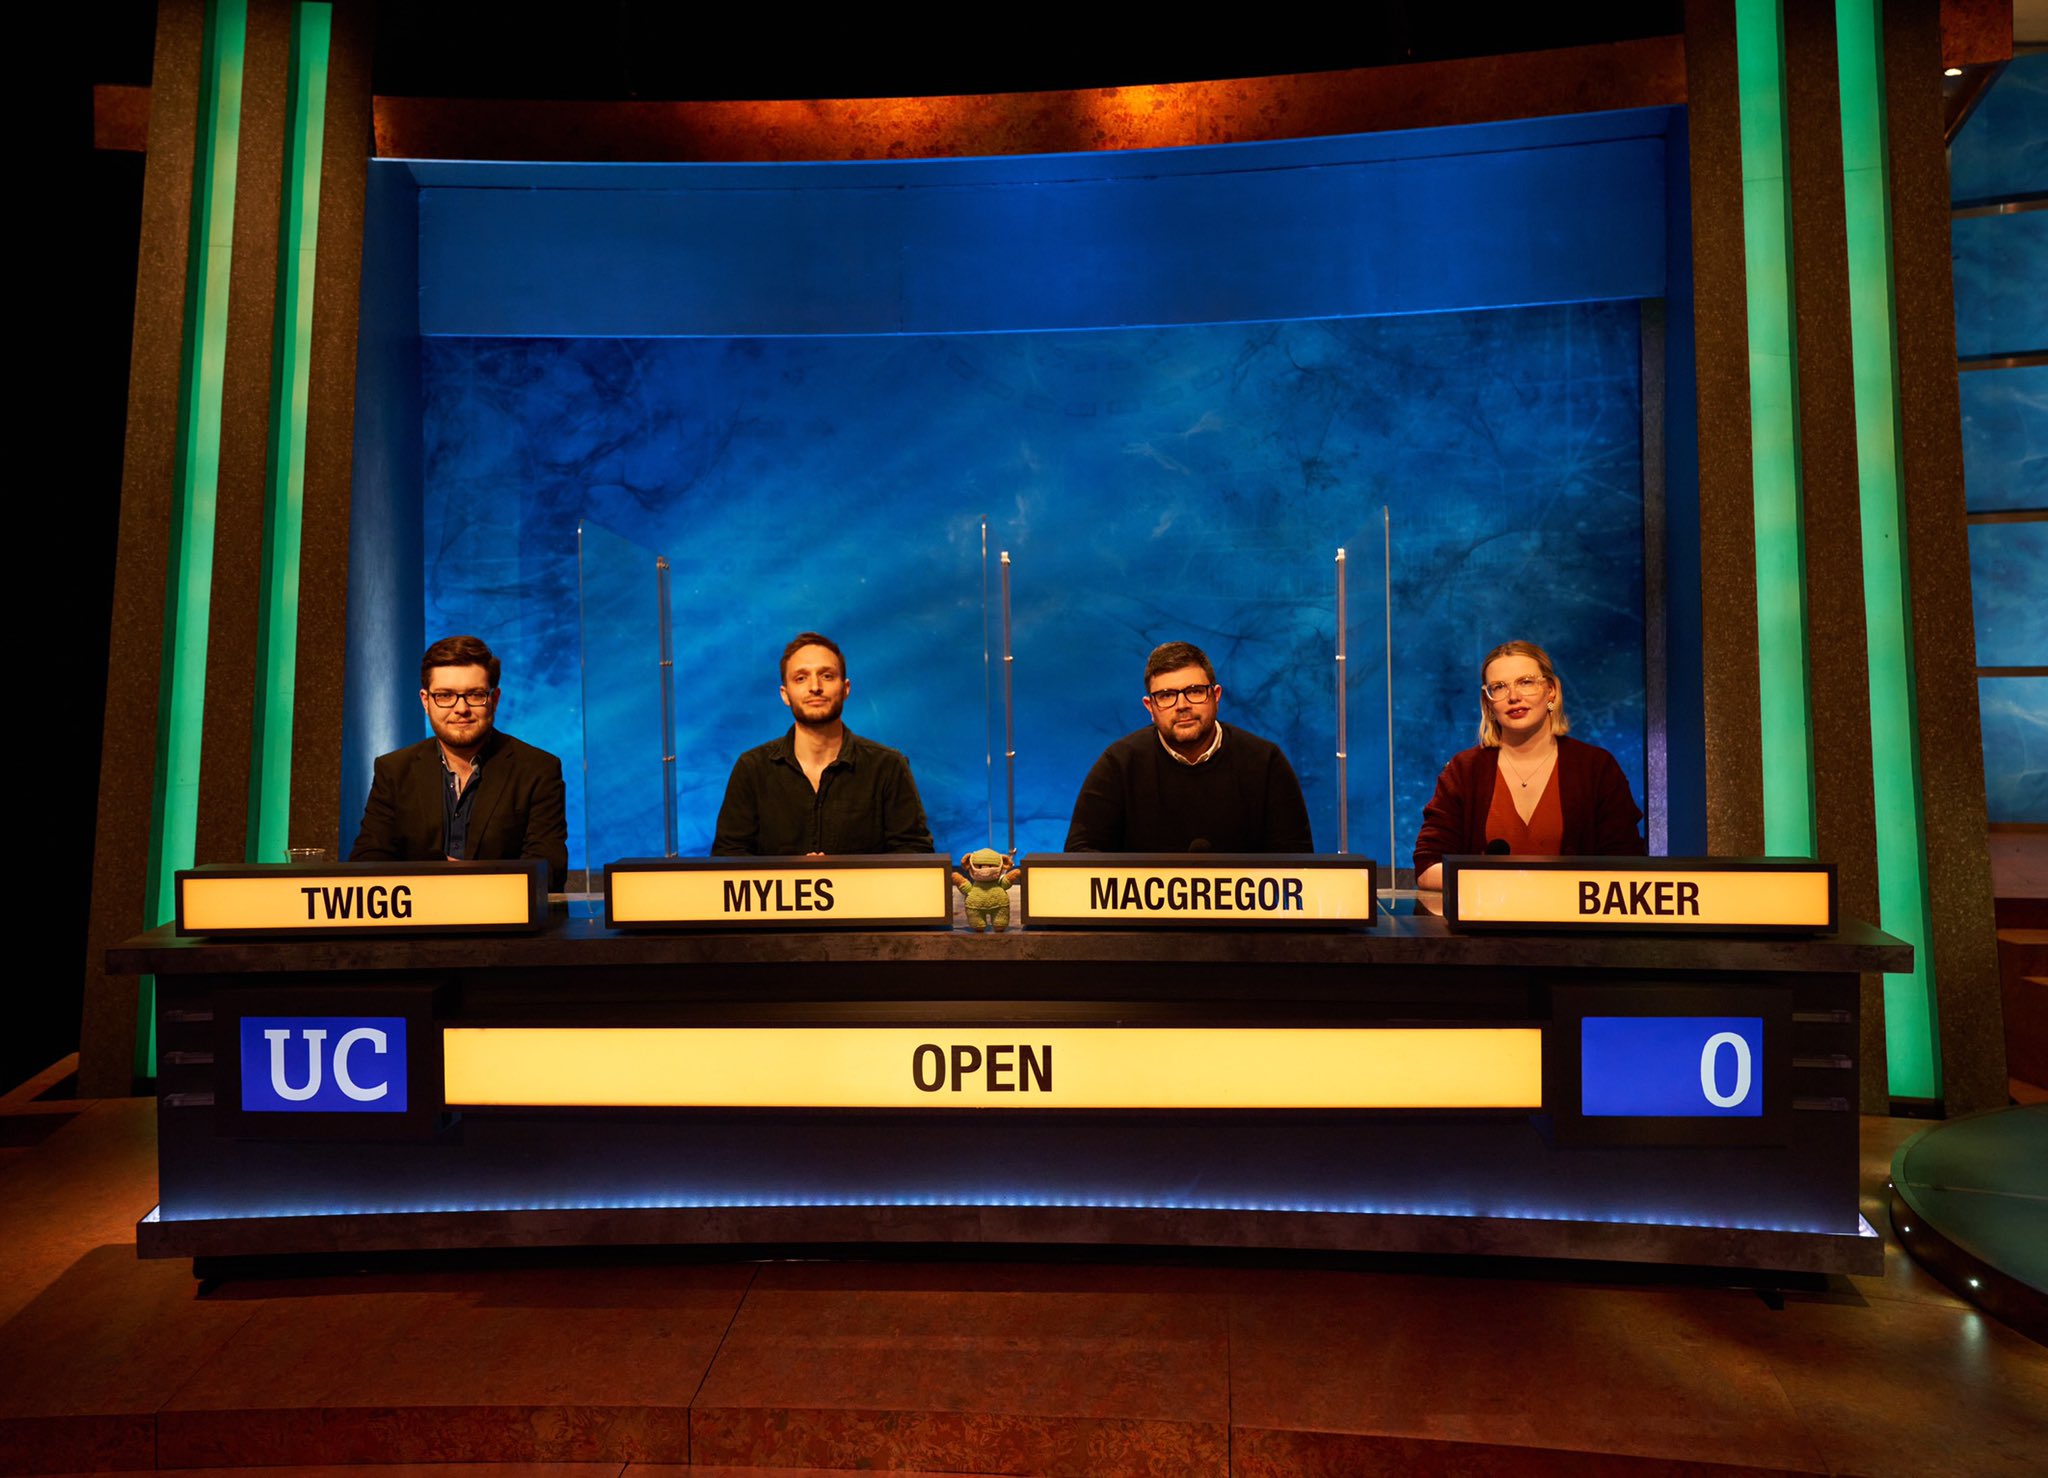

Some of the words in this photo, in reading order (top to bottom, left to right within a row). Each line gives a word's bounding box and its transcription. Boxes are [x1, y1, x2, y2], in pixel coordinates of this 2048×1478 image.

[301, 885, 412, 920] TWIGG
[724, 879, 834, 912] MYLES
[1091, 877, 1304, 911] MACGREGOR
[1579, 881, 1700, 916] BAKER
[264, 1027, 388, 1102] UC
[913, 1044, 1052, 1092] OPEN
[1700, 1031, 1751, 1108] 0
